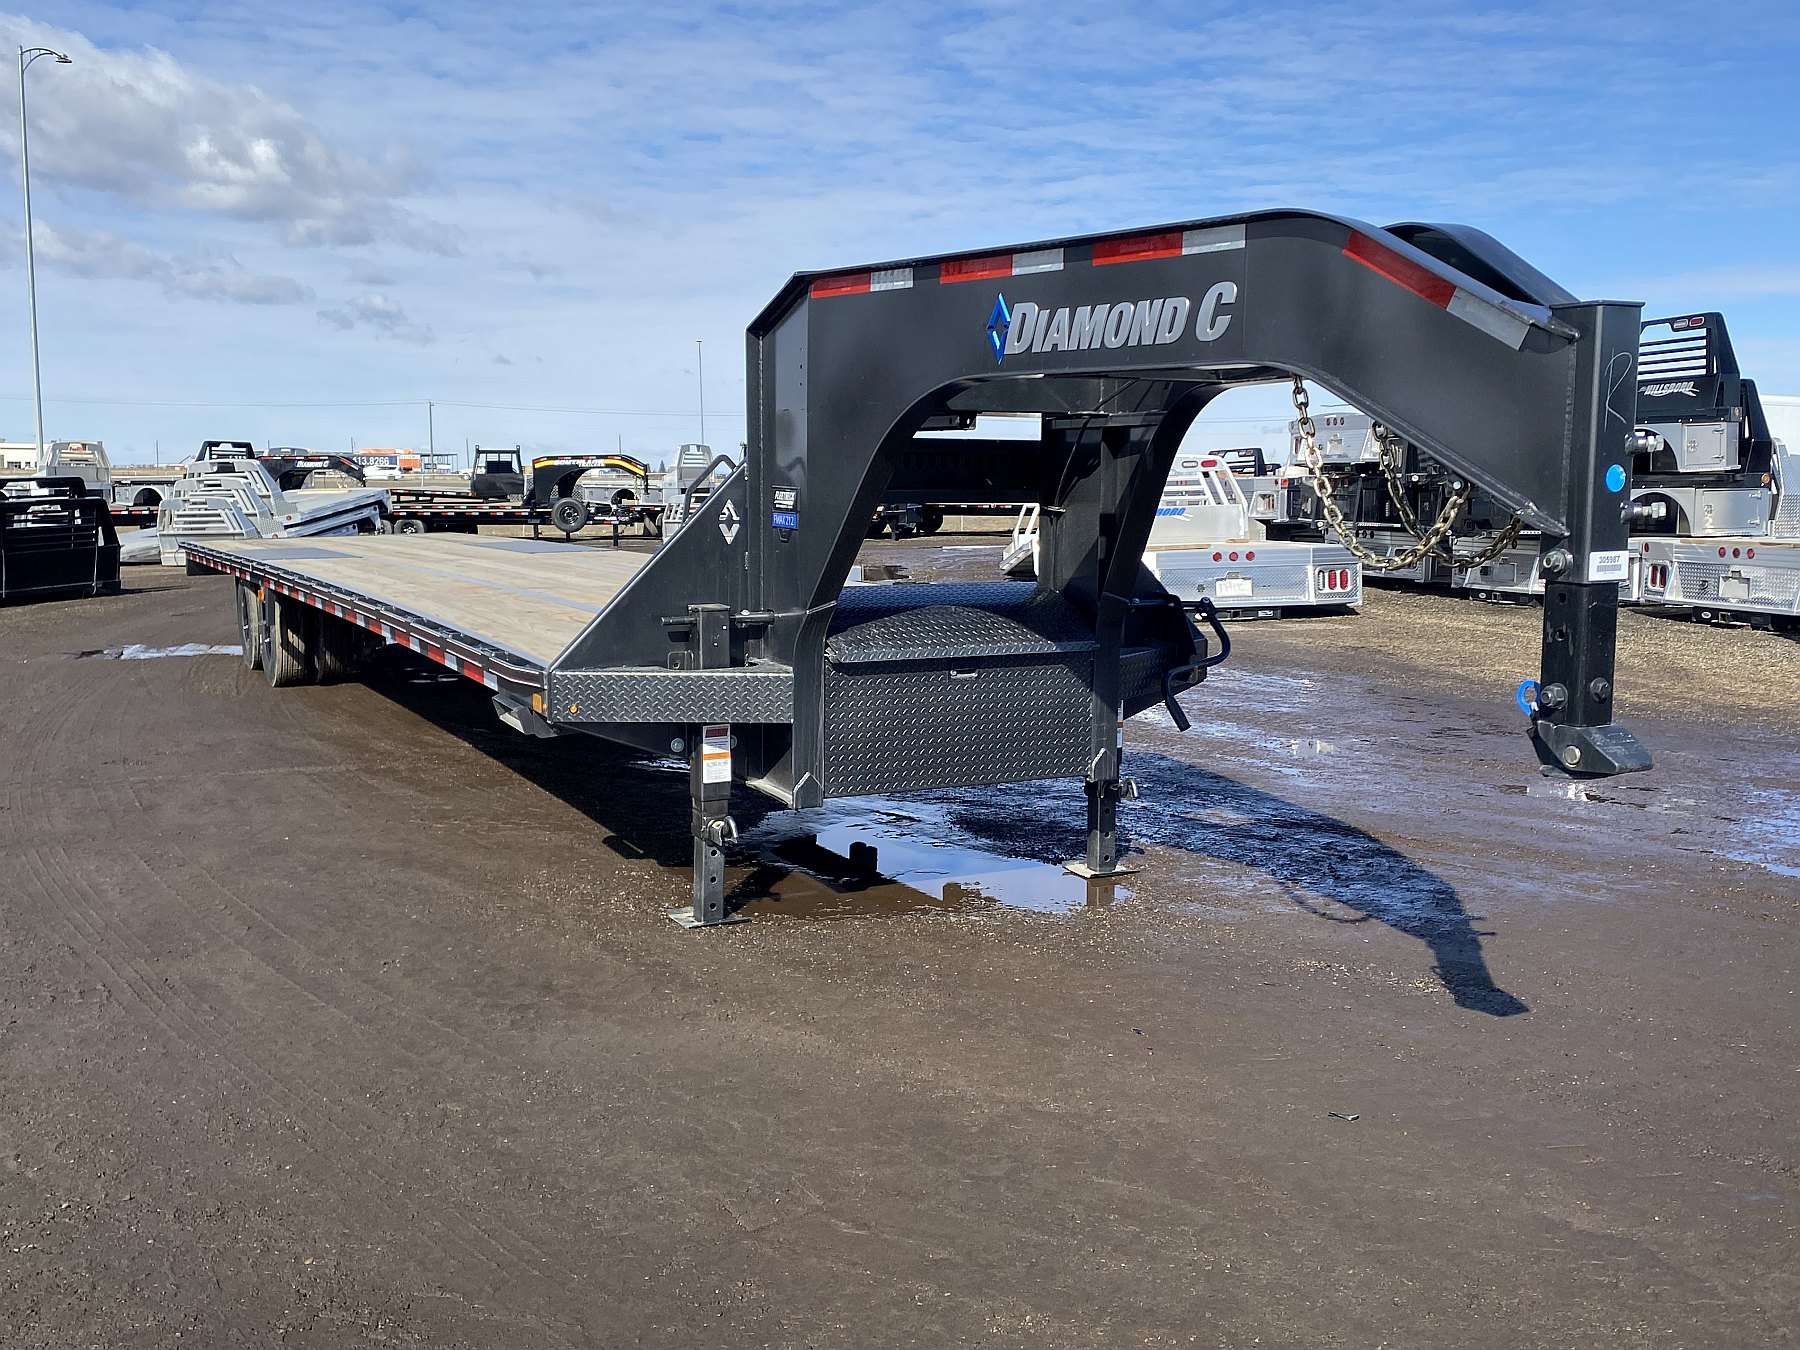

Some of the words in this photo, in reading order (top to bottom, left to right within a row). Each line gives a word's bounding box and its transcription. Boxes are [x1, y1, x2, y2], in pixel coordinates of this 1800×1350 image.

[1004, 297, 1189, 354] DIAMOND
[1195, 281, 1238, 342] C
[1643, 381, 1695, 396] HILLSBORO
